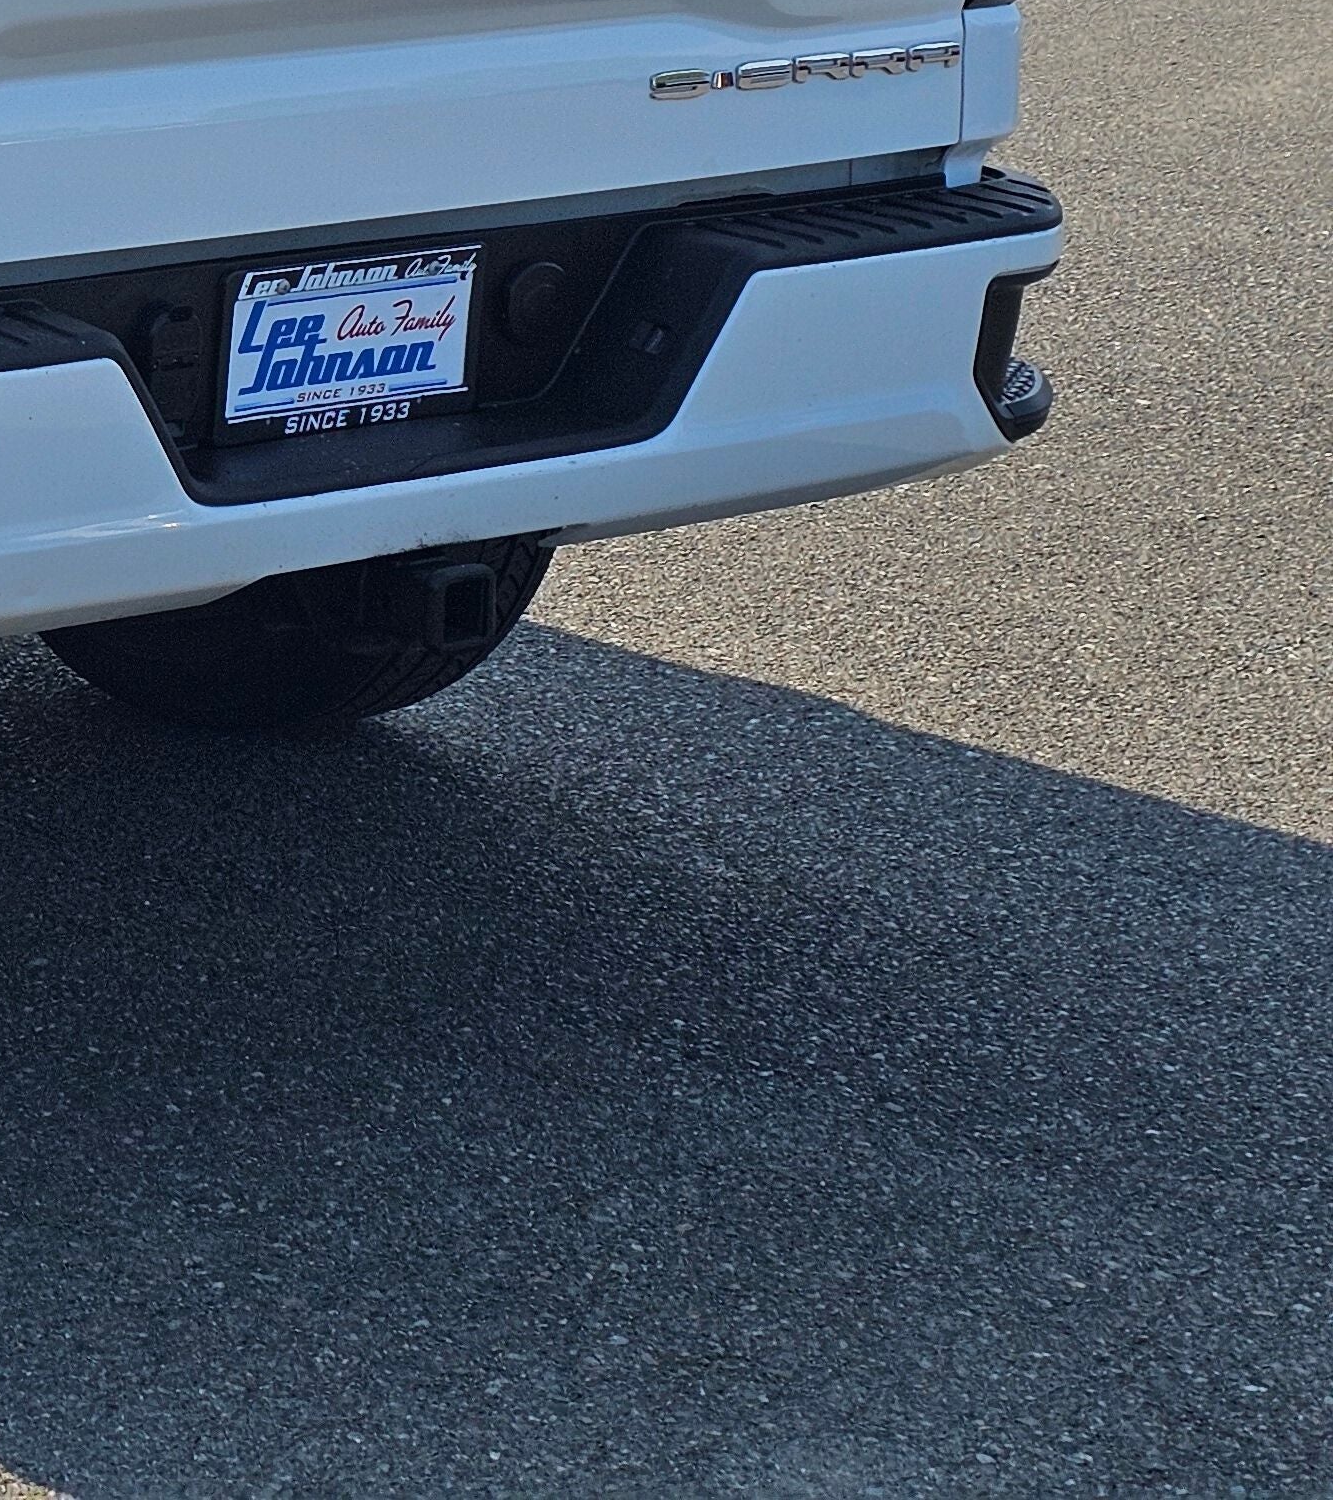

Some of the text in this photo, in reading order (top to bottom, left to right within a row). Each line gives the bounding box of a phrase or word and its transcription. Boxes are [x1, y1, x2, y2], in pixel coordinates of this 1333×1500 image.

[649, 41, 960, 100] SIERRA
[290, 262, 398, 292] Johnson
[405, 257, 434, 279] Aut
[436, 252, 478, 281] Family
[238, 300, 327, 355] Lee
[337, 295, 456, 341] Auto Family
[238, 335, 436, 396] Johnson
[296, 382, 386, 403] SINCE 1933
[284, 400, 410, 435] SINCE 1933
